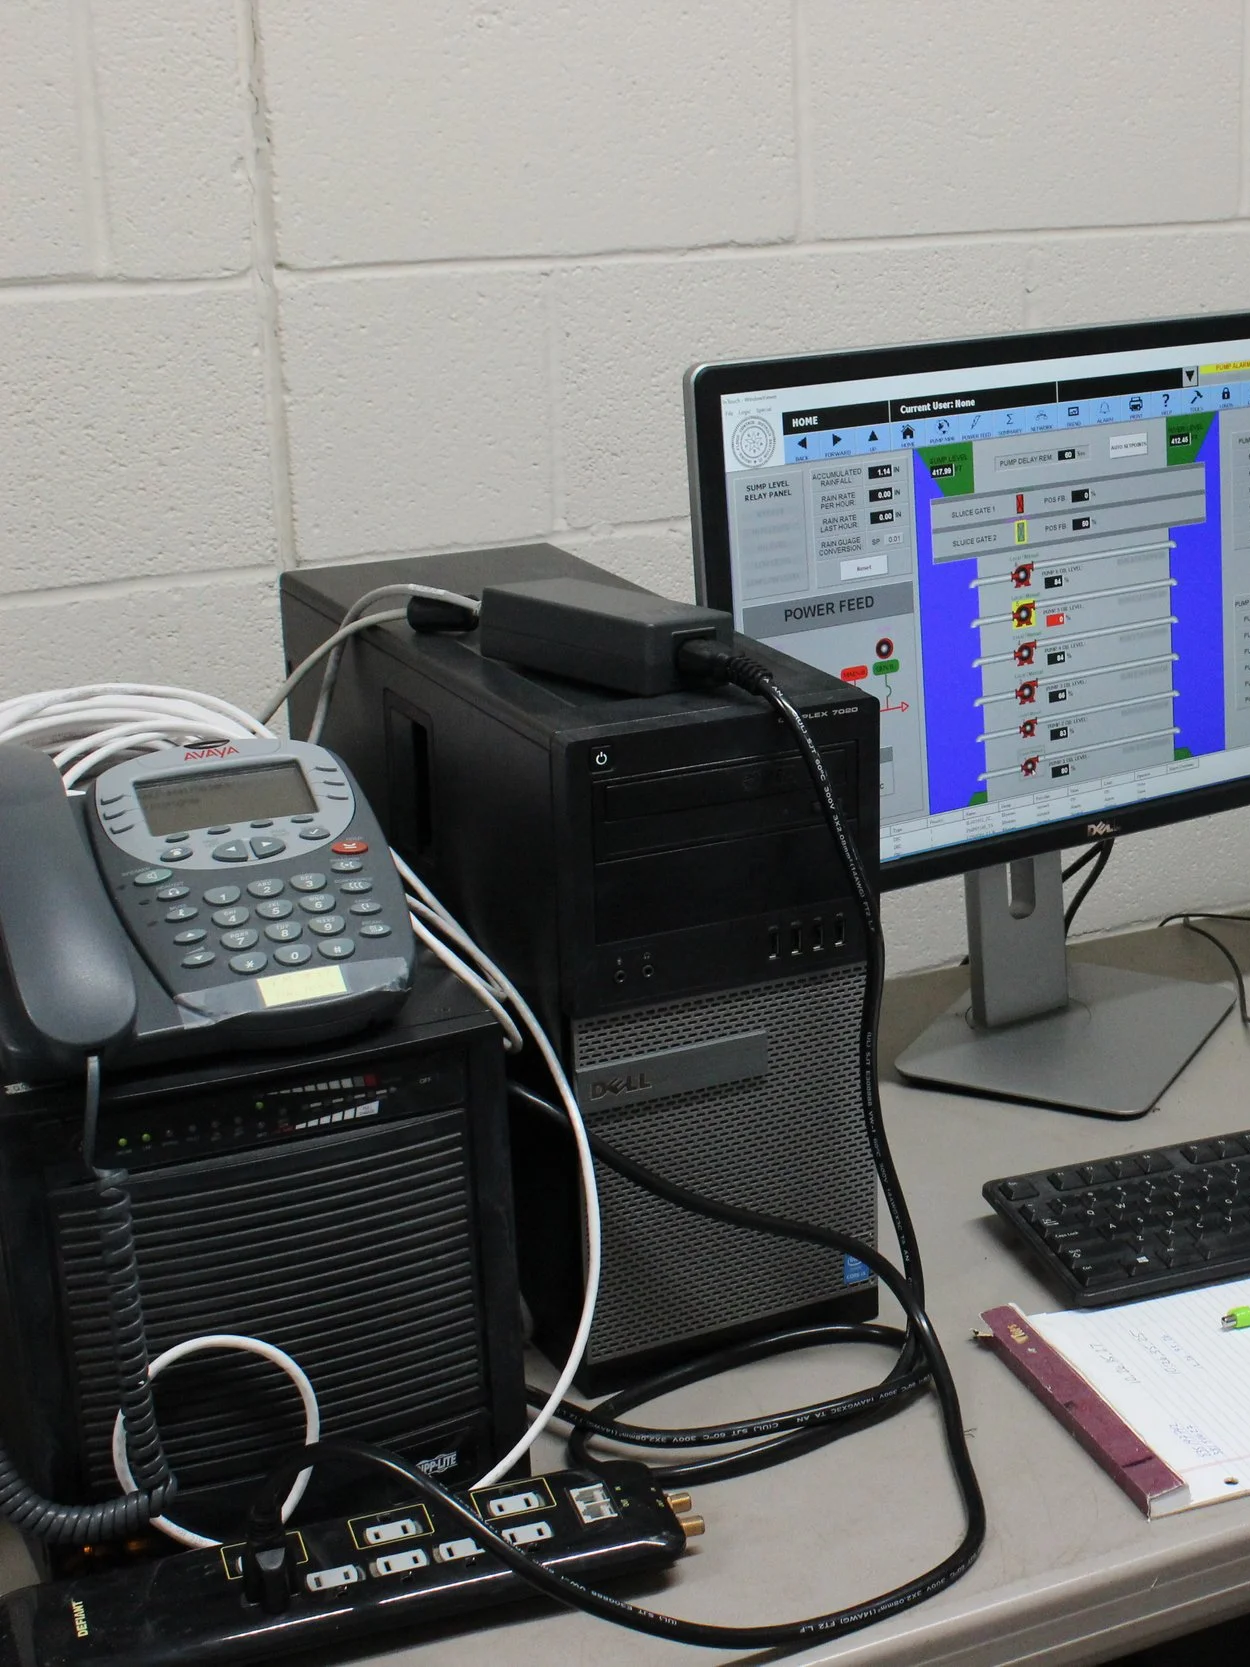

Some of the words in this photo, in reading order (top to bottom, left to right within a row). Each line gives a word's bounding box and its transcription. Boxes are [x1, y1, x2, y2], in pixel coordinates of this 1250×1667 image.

[1232, 361, 1250, 369] ALARM
[900, 402, 931, 414] Current
[932, 401, 954, 411] User:
[955, 398, 976, 408] None
[792, 416, 818, 428] HOME
[824, 450, 851, 458] FORWARD
[1000, 458, 1017, 466] PUMP
[1018, 456, 1038, 465] DELAY
[1039, 454, 1052, 462] REM
[812, 468, 862, 481] ACCUMULATED
[877, 468, 891, 477] 1.14
[893, 466, 900, 474] IN
[932, 467, 952, 477] 417.99
[746, 482, 767, 492] SUMP
[769, 480, 790, 489] LEVEL
[820, 477, 852, 486] RAINFALL
[744, 492, 767, 501] RELAY
[769, 489, 792, 499] PANEL
[838, 492, 856, 500] RATE
[877, 490, 892, 499] 0.00
[821, 502, 834, 510] PER
[835, 500, 854, 508] HOUR
[839, 514, 857, 522] RATE
[879, 512, 892, 521] 0.00
[952, 510, 974, 518] SLUICE
[975, 508, 992, 516] GATE
[820, 524, 837, 533] LAST
[838, 522, 858, 531] HOUR
[821, 541, 835, 549] RAIN
[837, 537, 861, 546] GUAGE
[952, 539, 975, 547] SLUICE
[976, 536, 992, 544] GATE
[819, 544, 862, 557] CONVERSION
[856, 564, 872, 572] Reset
[784, 602, 835, 622] POWER
[839, 595, 874, 613] FEED
[771, 686, 784, 697] AN
[832, 706, 858, 716] 7020
[184, 746, 240, 762] AVAYA
[806, 737, 818, 755] SJT
[814, 758, 826, 782] 60°C
[823, 786, 836, 811] 300V
[263, 886, 271, 894] 2
[271, 906, 280, 915] 5
[324, 922, 332, 931] 9
[281, 929, 288, 937] 8
[237, 937, 245, 946] 7
[291, 952, 299, 960] 0
[590, 1073, 652, 1101] DELL
[796, 1414, 810, 1424] AN
[814, 1410, 826, 1419] TA
[731, 1426, 748, 1438] SJT
[672, 1434, 697, 1444] 300V
[71, 1598, 88, 1638] DEFIANT
[638, 1608, 654, 1618] SJT
[659, 1615, 678, 1626] (UL)
